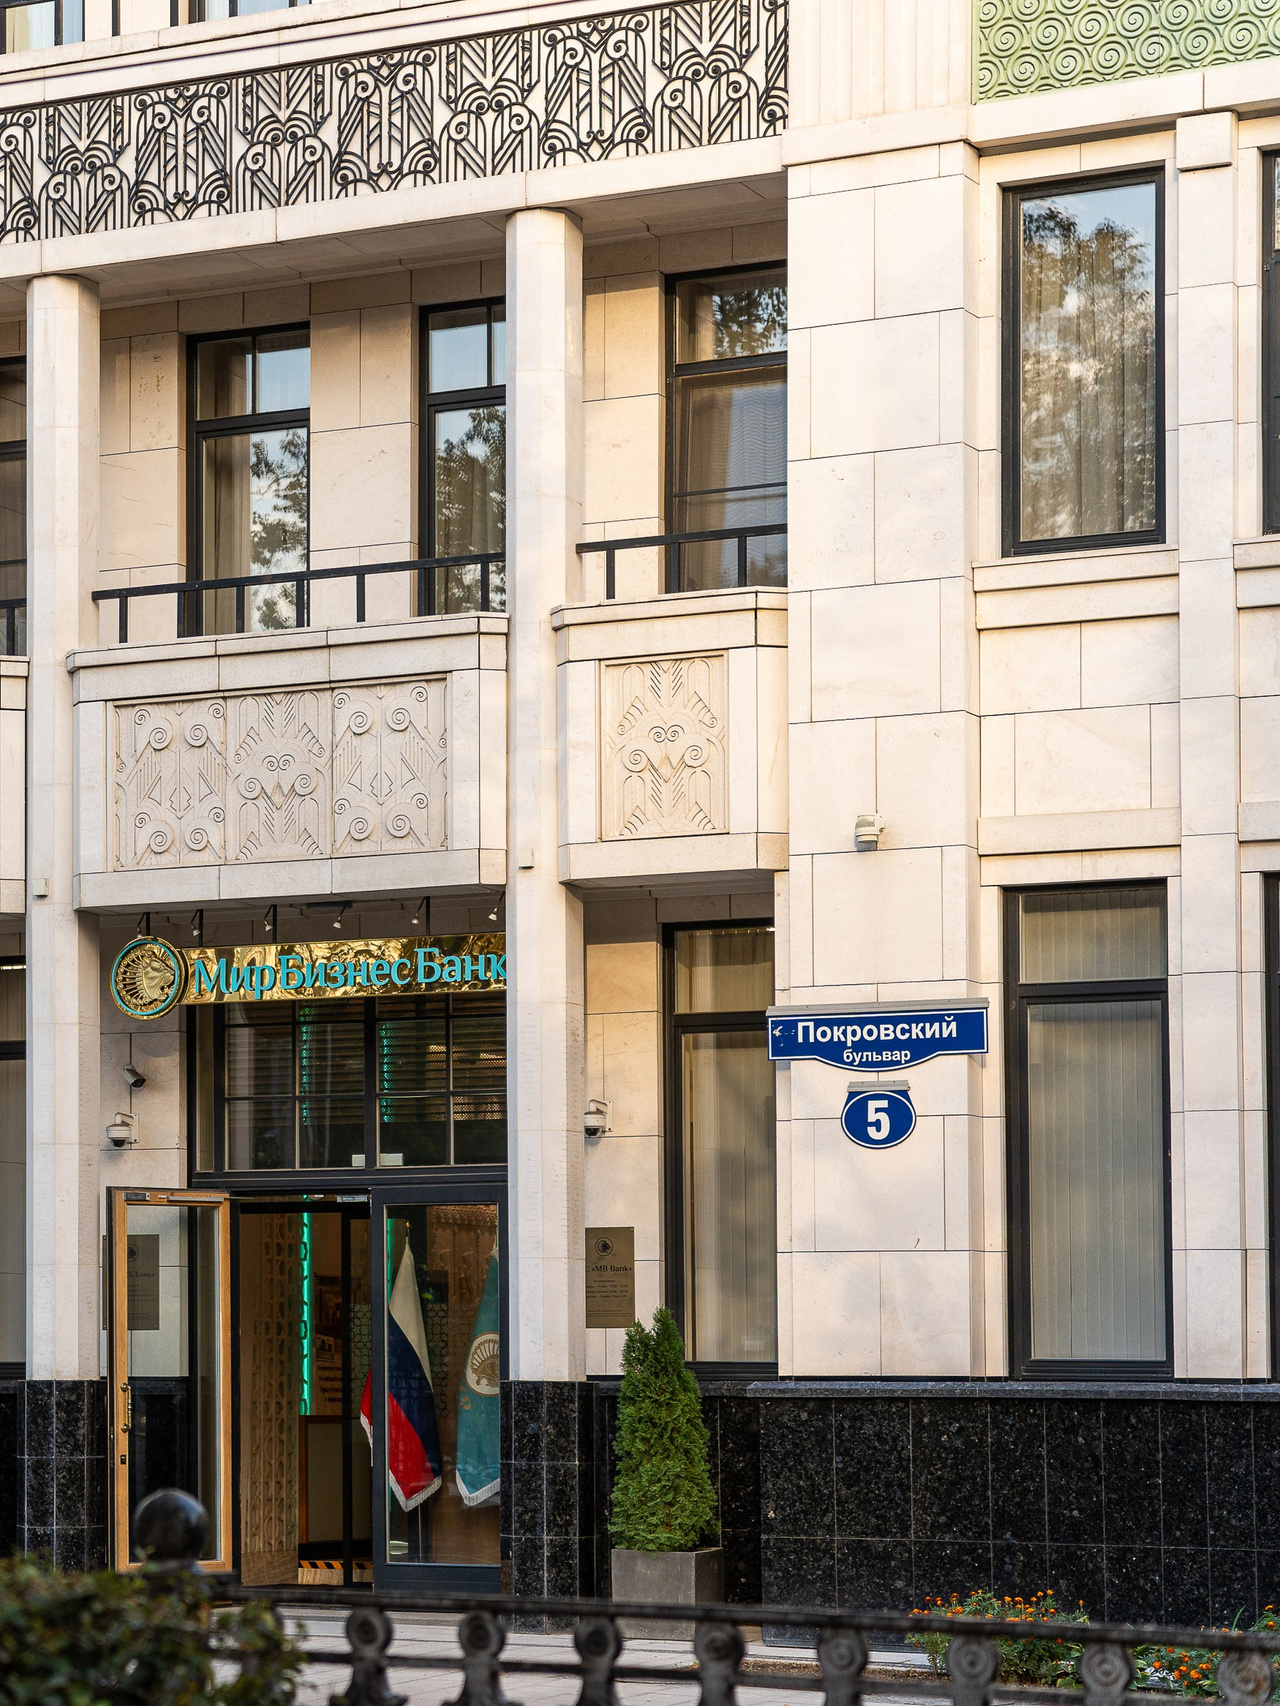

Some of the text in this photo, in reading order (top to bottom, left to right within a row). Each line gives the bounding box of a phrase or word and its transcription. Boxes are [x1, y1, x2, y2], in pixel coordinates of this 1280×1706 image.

[797, 1015, 957, 1047] Покровский
[843, 1049, 911, 1065] бульвар
[867, 1099, 891, 1141] 5
